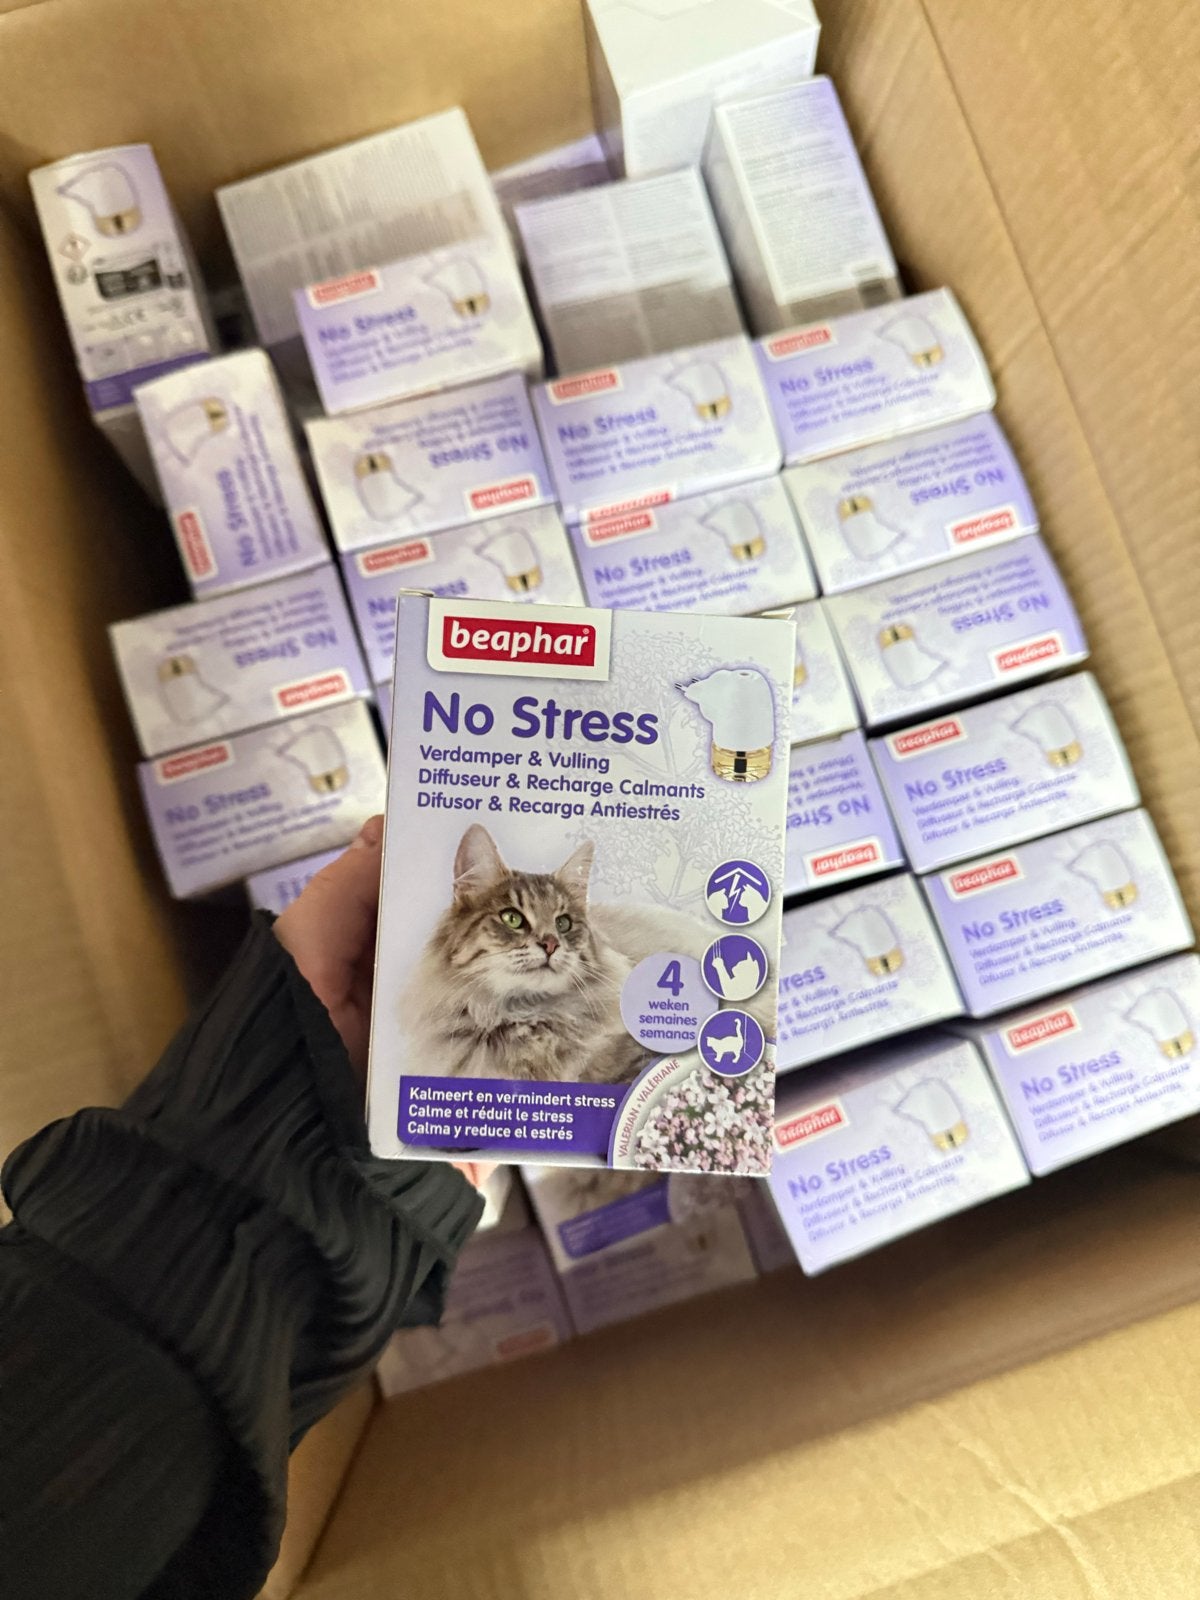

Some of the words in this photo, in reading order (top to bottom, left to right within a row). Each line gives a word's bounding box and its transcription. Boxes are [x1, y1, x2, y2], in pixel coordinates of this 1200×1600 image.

[975, 469, 1002, 486] No
[911, 479, 970, 506] Stress
[596, 567, 625, 584] No
[631, 550, 691, 574] Stress
[1019, 593, 1047, 611] No
[953, 605, 1014, 634] Stress
[450, 620, 588, 658] beaphar
[423, 691, 494, 735] No
[512, 696, 658, 745] Stress
[898, 725, 955, 750] beaphar
[420, 745, 522, 767] Verdamper
[528, 751, 542, 767] &
[549, 752, 610, 773] Vulling
[419, 768, 500, 788] Diffuseur
[506, 774, 520, 789] &
[527, 774, 613, 797] Recharge
[619, 780, 705, 799] Calmants
[905, 781, 938, 801] No
[943, 758, 1007, 788] Stress
[417, 792, 482, 811] Difusor
[488, 796, 502, 811] &
[509, 797, 584, 819] Recarga
[591, 801, 680, 821] Antiestrés
[786, 805, 833, 829] Stre
[837, 794, 871, 816] No
[815, 846, 874, 873] beaphar
[955, 864, 1012, 889] beaphar
[962, 922, 994, 942] No
[1000, 899, 1063, 929] Stress
[657, 960, 684, 997] 4
[779, 966, 826, 994] ress
[649, 998, 690, 1011] weken
[639, 1013, 697, 1026] semaines
[1011, 1015, 1067, 1044] beaphar
[640, 1029, 696, 1040] semanas
[1021, 1076, 1053, 1098] No
[1058, 1050, 1120, 1083] Stress
[410, 1087, 473, 1102] Kalmeert
[476, 1091, 493, 1102] en
[496, 1091, 572, 1107] vermindert
[574, 1095, 616, 1108] stress
[619, 1108, 639, 1157] VALERIAN
[637, 1059, 680, 1102] VALÉRIANE
[409, 1104, 452, 1118] Calme
[455, 1106, 469, 1119] et
[472, 1106, 513, 1121] réduit
[516, 1109, 529, 1121] le
[532, 1110, 574, 1123] stress
[408, 1122, 450, 1135] Calma
[453, 1126, 462, 1138] y
[465, 1124, 511, 1138] reduce
[514, 1126, 528, 1138] el
[530, 1126, 574, 1140] estrés
[789, 1174, 821, 1198] No
[826, 1144, 890, 1181] Stress
